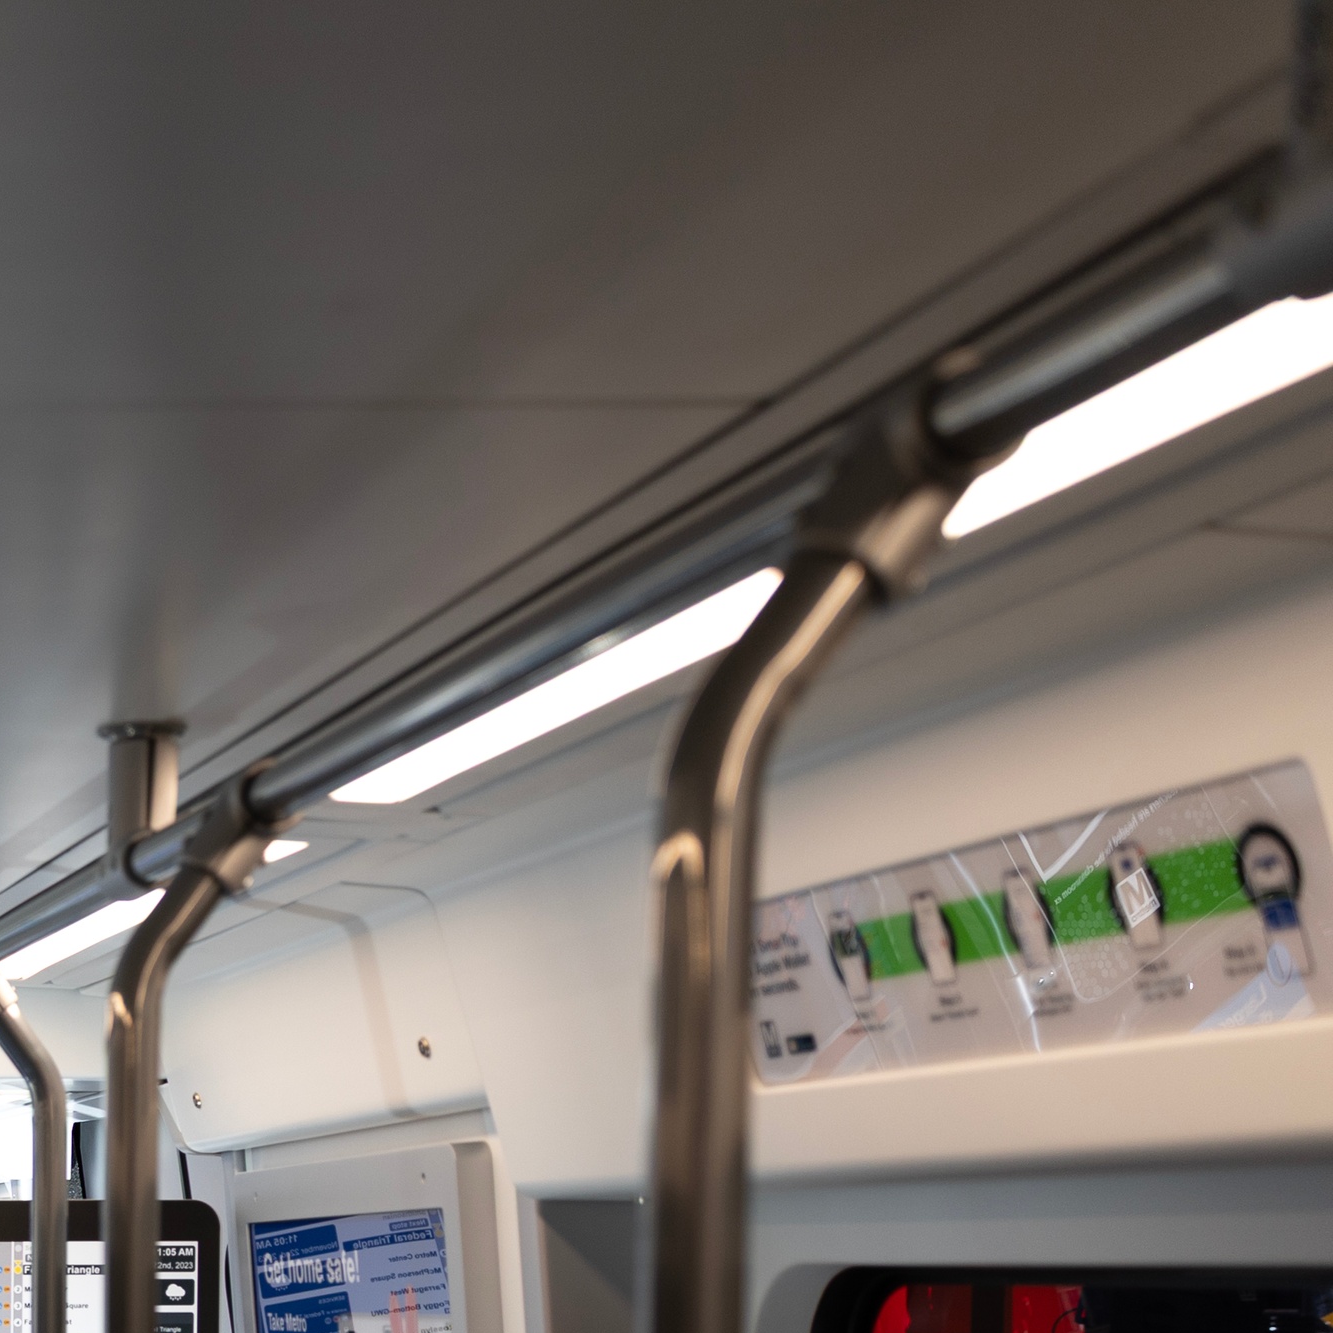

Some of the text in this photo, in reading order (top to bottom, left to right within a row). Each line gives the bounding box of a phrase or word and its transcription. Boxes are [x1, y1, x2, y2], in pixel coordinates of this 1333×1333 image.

[157, 1248, 193, 1256] 1:05 AM
[67, 1265, 100, 1275] riangle
[264, 1250, 361, 1284] Get home safe!
[267, 1312, 307, 1333] Take Metro
